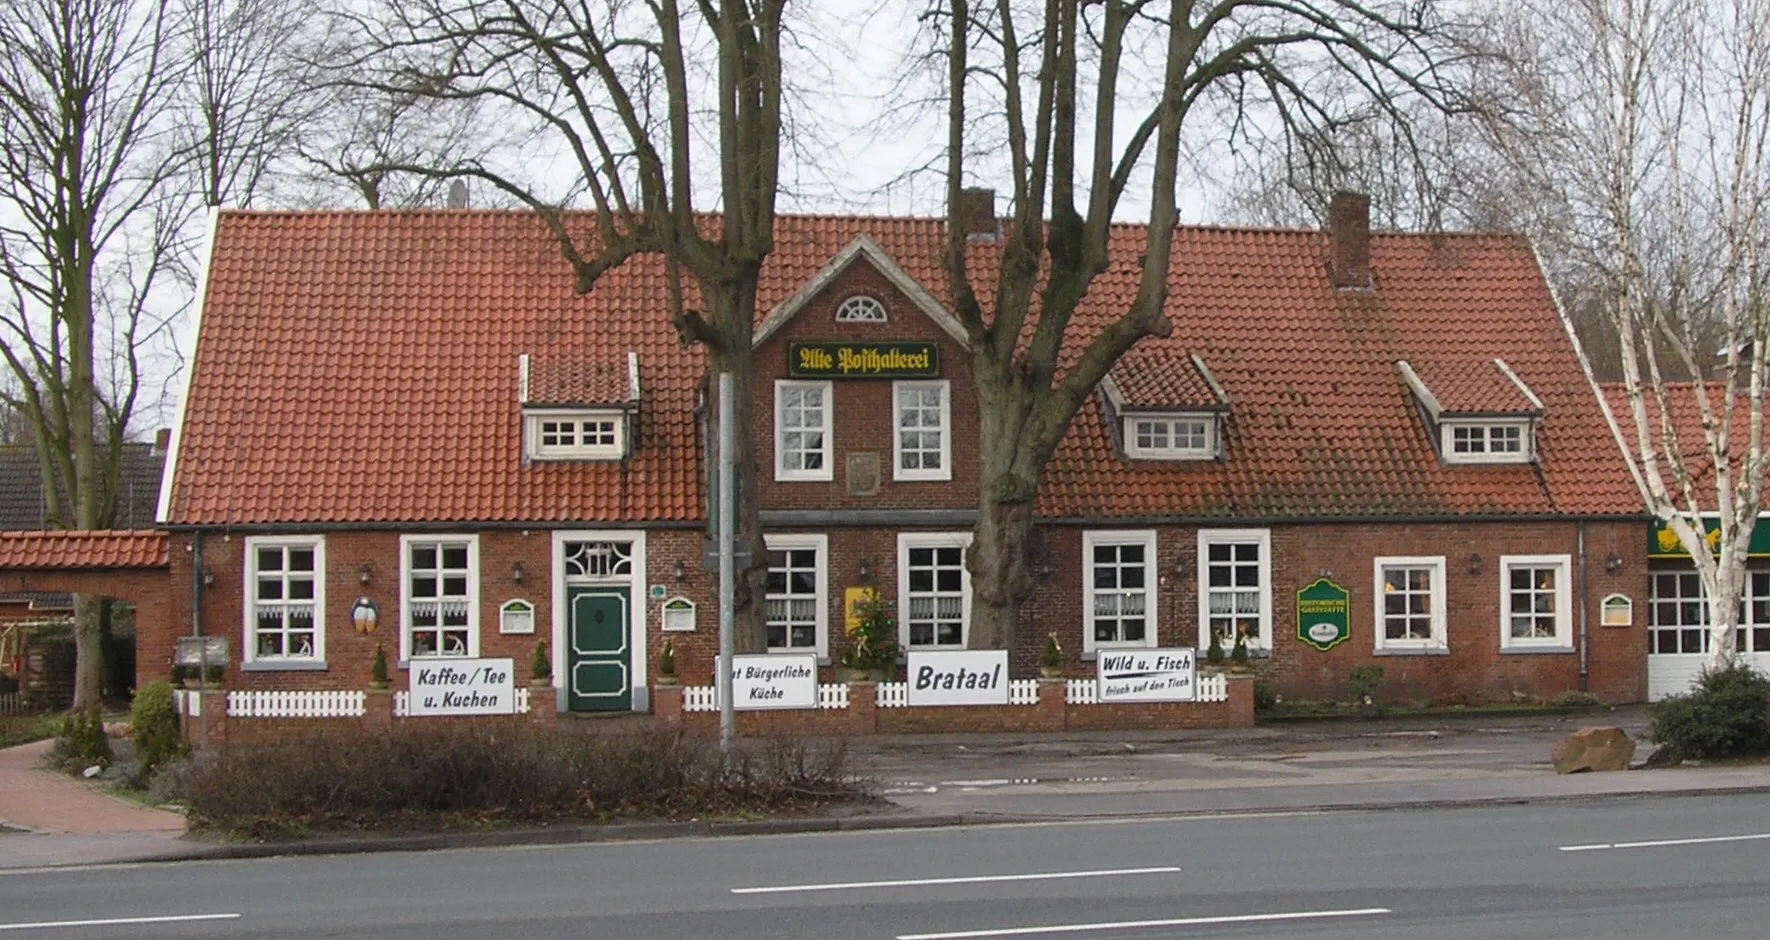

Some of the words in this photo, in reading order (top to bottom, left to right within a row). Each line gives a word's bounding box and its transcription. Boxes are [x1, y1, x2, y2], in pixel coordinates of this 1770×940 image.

[799, 347, 833, 369] Alte
[1103, 655, 1134, 671] Wild
[1137, 660, 1150, 671] u.
[1155, 654, 1191, 670] Fisch
[417, 667, 467, 685] Kaffee
[483, 667, 506, 684] Tee
[745, 664, 812, 682] Bürgerliche
[915, 663, 1001, 690] Brataal
[749, 686, 785, 700] Küche
[1105, 684, 1130, 697] frisch
[1132, 681, 1148, 694] auf
[1149, 679, 1165, 691] den
[1168, 676, 1190, 689] Tisch
[423, 696, 438, 708] u.
[442, 690, 498, 708] Kuchen
